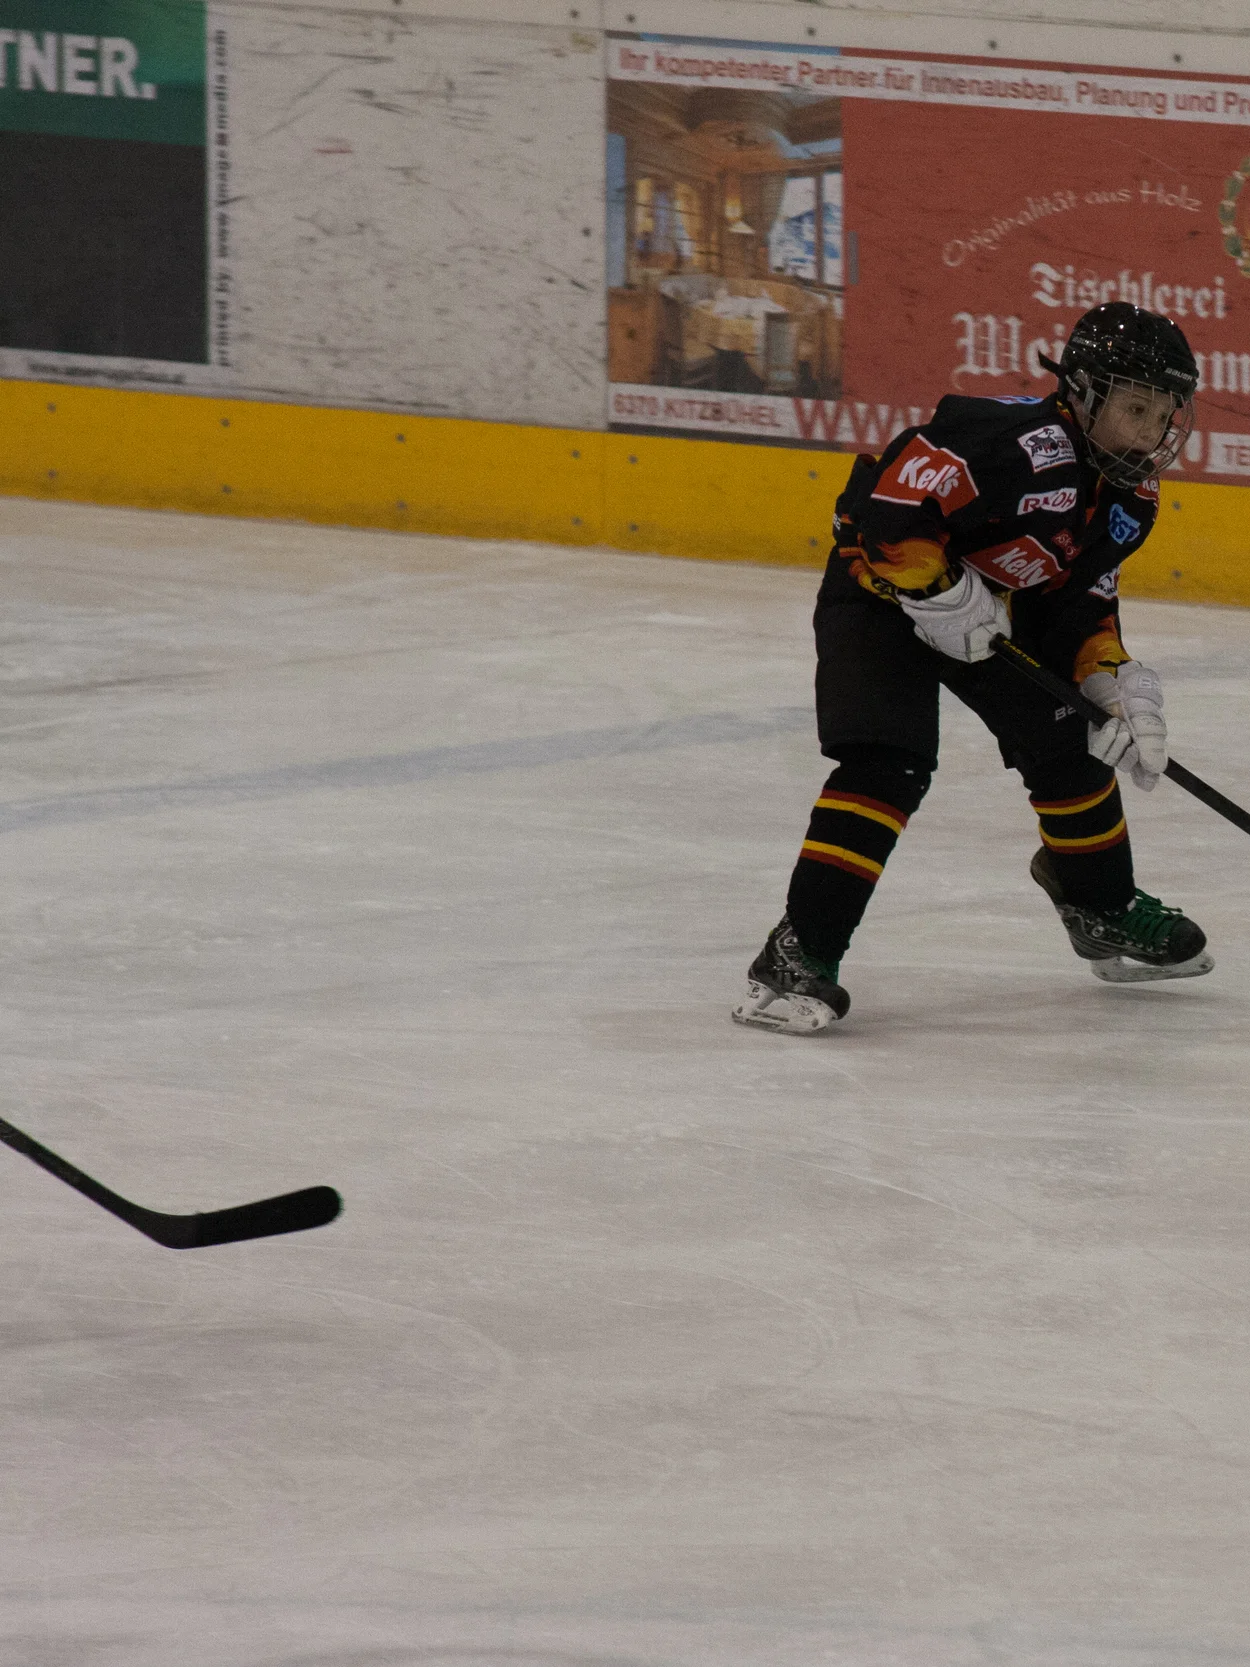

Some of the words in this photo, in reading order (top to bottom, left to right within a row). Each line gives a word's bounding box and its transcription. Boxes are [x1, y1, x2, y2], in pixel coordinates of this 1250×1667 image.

[619, 48, 648, 71] Ihr
[655, 50, 791, 83] kompetenter
[798, 61, 879, 88] Partner
[883, 66, 916, 92] für
[1075, 80, 1167, 115] Planung
[1174, 89, 1217, 114] und
[1084, 188, 1133, 205] aus
[1139, 180, 1203, 213] Holz
[1029, 262, 1229, 319] Tischlerei
[215, 299, 232, 367] printed
[1164, 367, 1193, 382] BAUER
